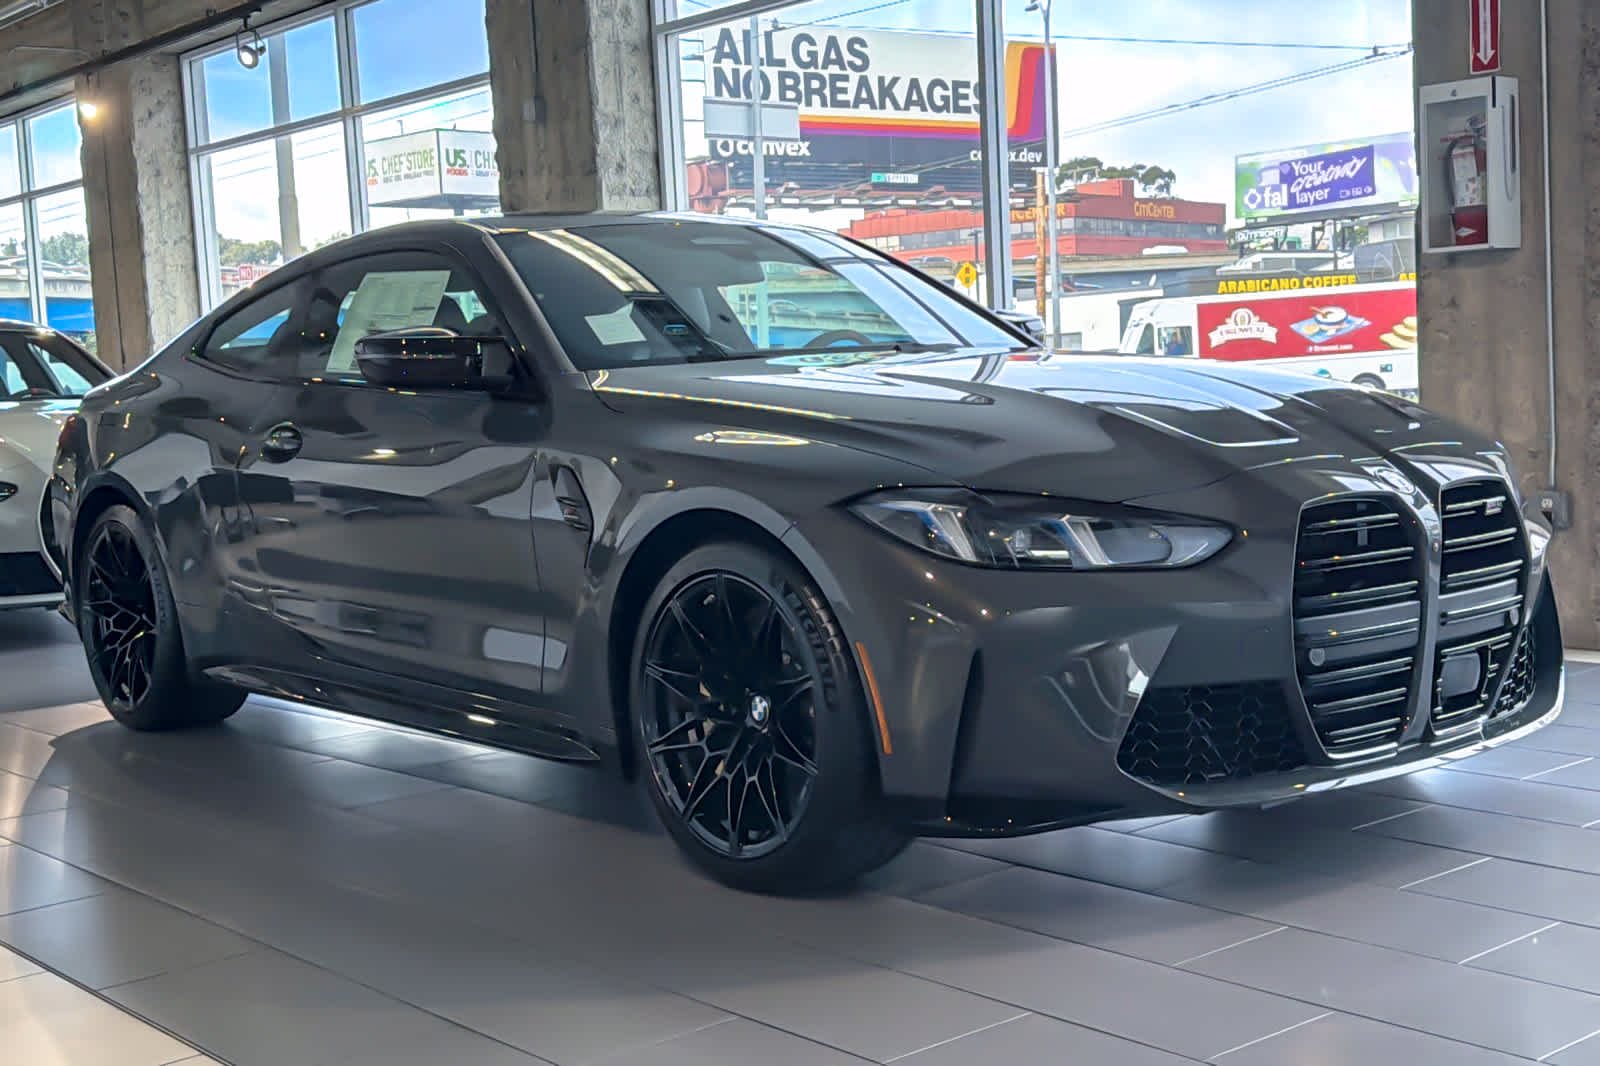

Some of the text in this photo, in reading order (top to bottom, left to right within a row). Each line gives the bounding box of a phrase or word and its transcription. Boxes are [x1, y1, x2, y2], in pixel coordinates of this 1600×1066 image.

[713, 28, 870, 73] ALL GAS
[713, 66, 771, 101] NO
[1289, 156, 1368, 193] creativity
[1291, 159, 1325, 176] Your
[1263, 183, 1289, 208] fal
[1295, 187, 1331, 206] layer
[1217, 274, 1357, 294] ARABICANO COFFEE
